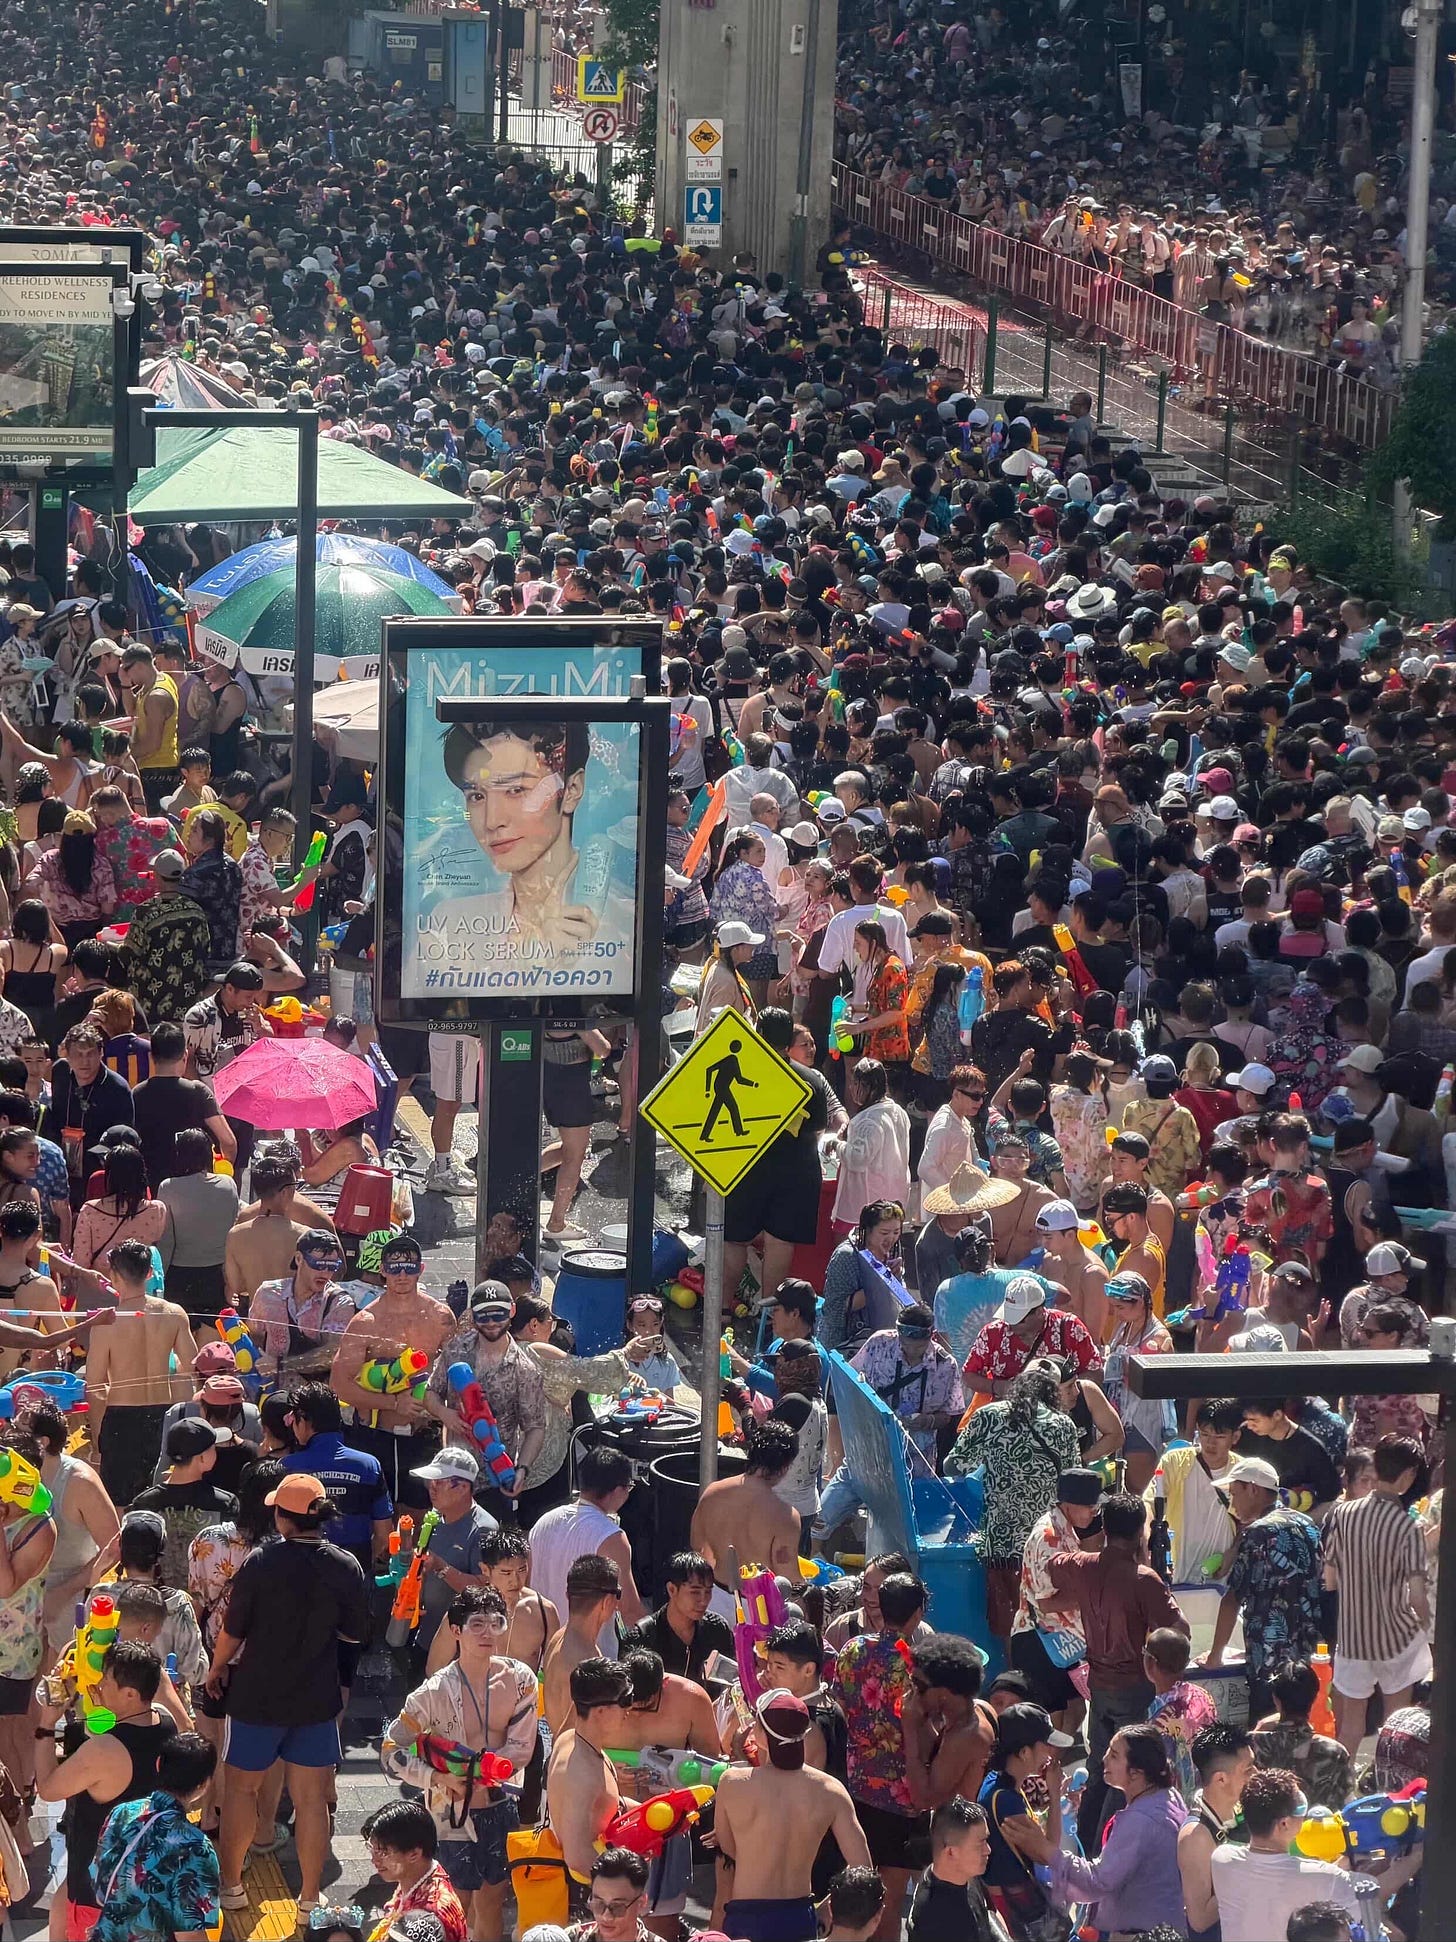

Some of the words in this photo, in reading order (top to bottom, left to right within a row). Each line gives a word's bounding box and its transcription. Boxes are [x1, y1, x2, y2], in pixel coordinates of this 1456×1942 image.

[55, 277, 108, 287] WELLNESS
[21, 290, 86, 301] RESIDENCES
[28, 310, 54, 318] MOVE
[56, 310, 65, 318] IN
[68, 311, 80, 319] BY
[84, 310, 99, 319] MID
[41, 436, 67, 444] STARTS
[69, 435, 89, 444] 21.9
[427, 660, 625, 706] MizuMi
[416, 914, 447, 935] UV
[454, 914, 520, 935] AQUA
[416, 942, 475, 960] LOCK
[484, 941, 555, 960] SERUM
[577, 942, 594, 950] SPF
[594, 940, 626, 958] 50+
[426, 965, 613, 988] #กันแดดฟ้าอควา
[428, 1022, 477, 1030] 02-965-9797
[310, 1470, 361, 1483] ANCHESTER
[326, 1486, 347, 1495] ITED
